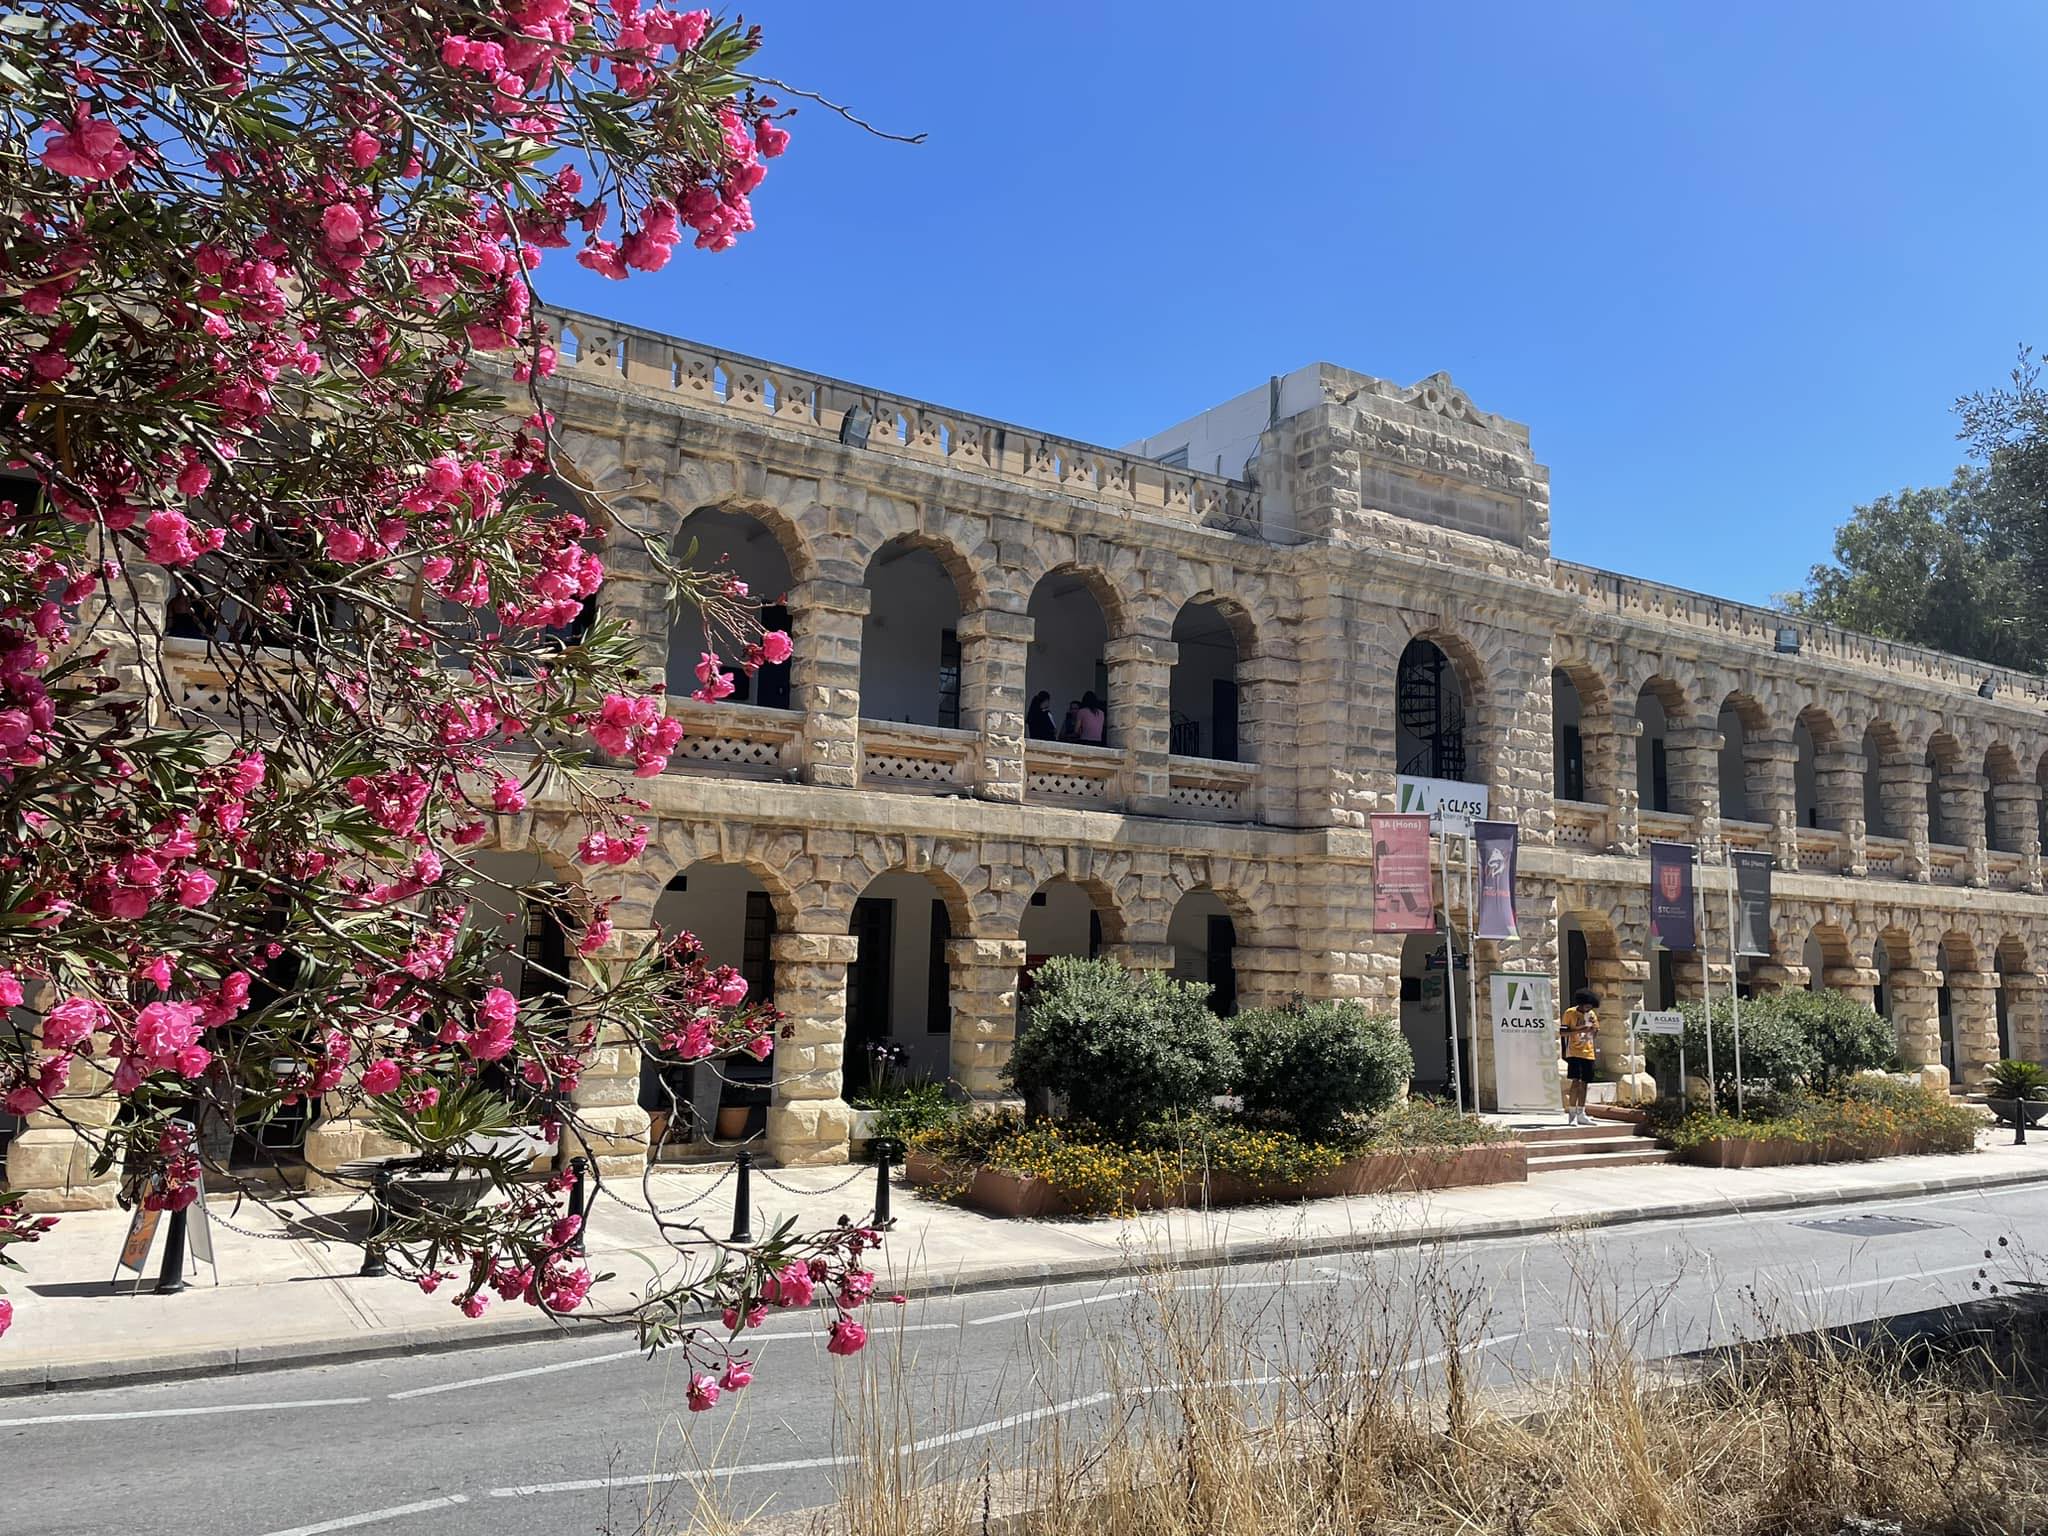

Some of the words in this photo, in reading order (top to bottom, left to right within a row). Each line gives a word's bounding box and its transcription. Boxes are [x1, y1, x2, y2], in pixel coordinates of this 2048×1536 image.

[1448, 799, 1482, 815] CLASS
[1379, 820, 1391, 829] BA
[1392, 819, 1422, 831] (Hons)
[1658, 905, 1671, 914] STC
[1501, 1017, 1509, 1028] A
[1511, 1017, 1545, 1029] CLASS
